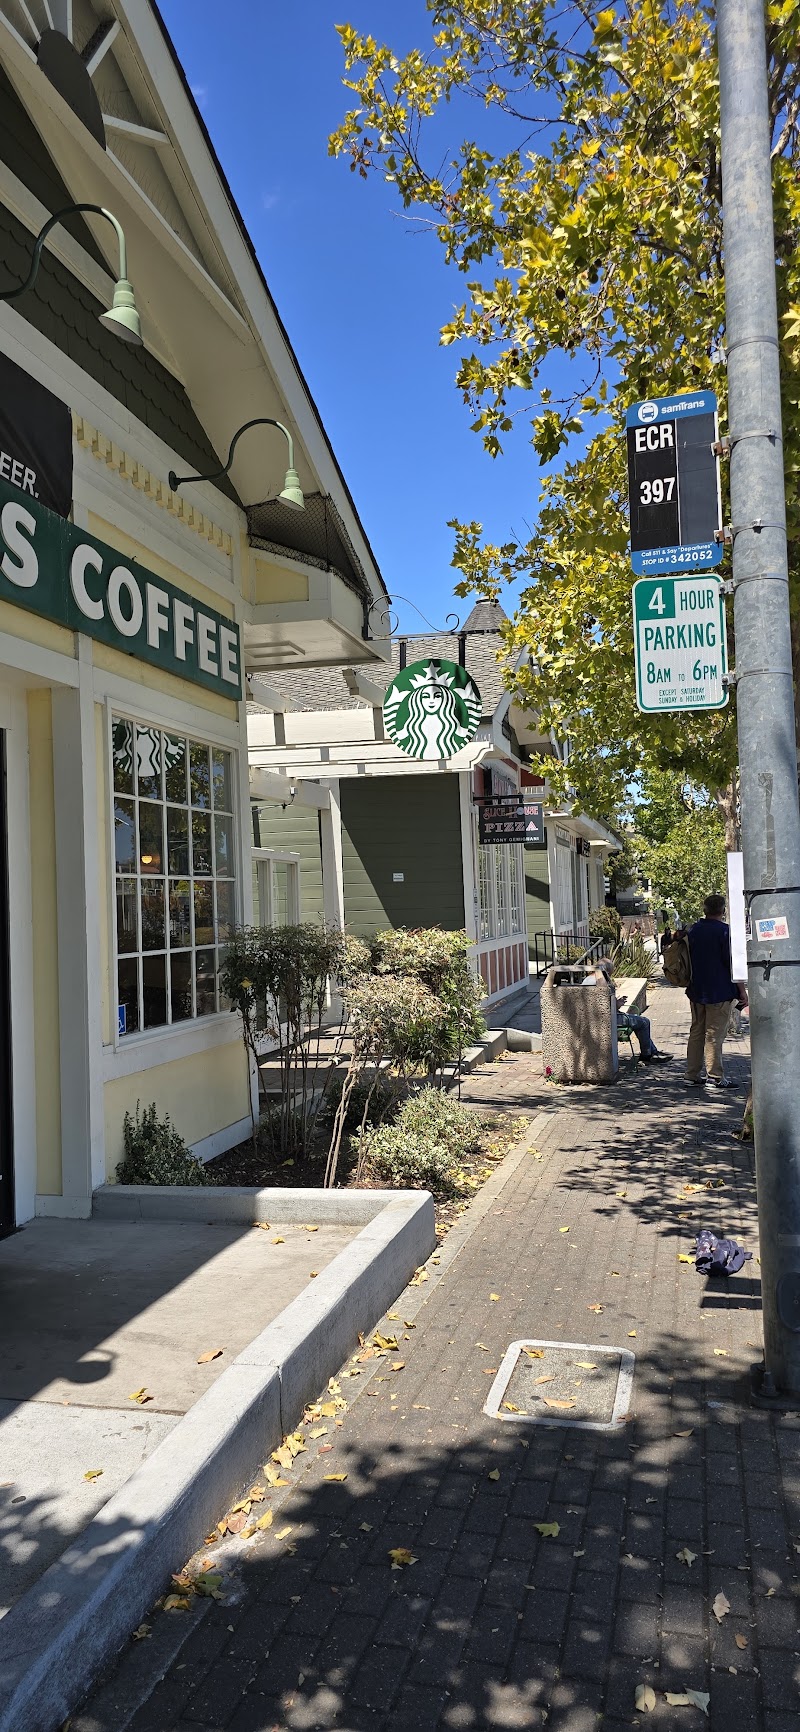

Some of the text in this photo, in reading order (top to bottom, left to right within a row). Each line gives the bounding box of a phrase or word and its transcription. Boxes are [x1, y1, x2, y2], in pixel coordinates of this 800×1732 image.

[661, 400, 705, 414] samTrans
[635, 423, 674, 452] ECR
[640, 477, 675, 505] 397
[642, 558, 657, 566] STOP
[671, 550, 713, 564] 342052
[1, 501, 240, 686] S COFFEE
[648, 587, 714, 615] 4 HOUR
[644, 622, 716, 651] PARKING
[647, 659, 718, 684] 8AM TO 6PM
[659, 687, 705, 697] EXCEPT SATURDAY
[659, 696, 677, 704] SUNDAY
[685, 694, 706, 702] HOLIDAY
[484, 821, 539, 833] PIZZA
